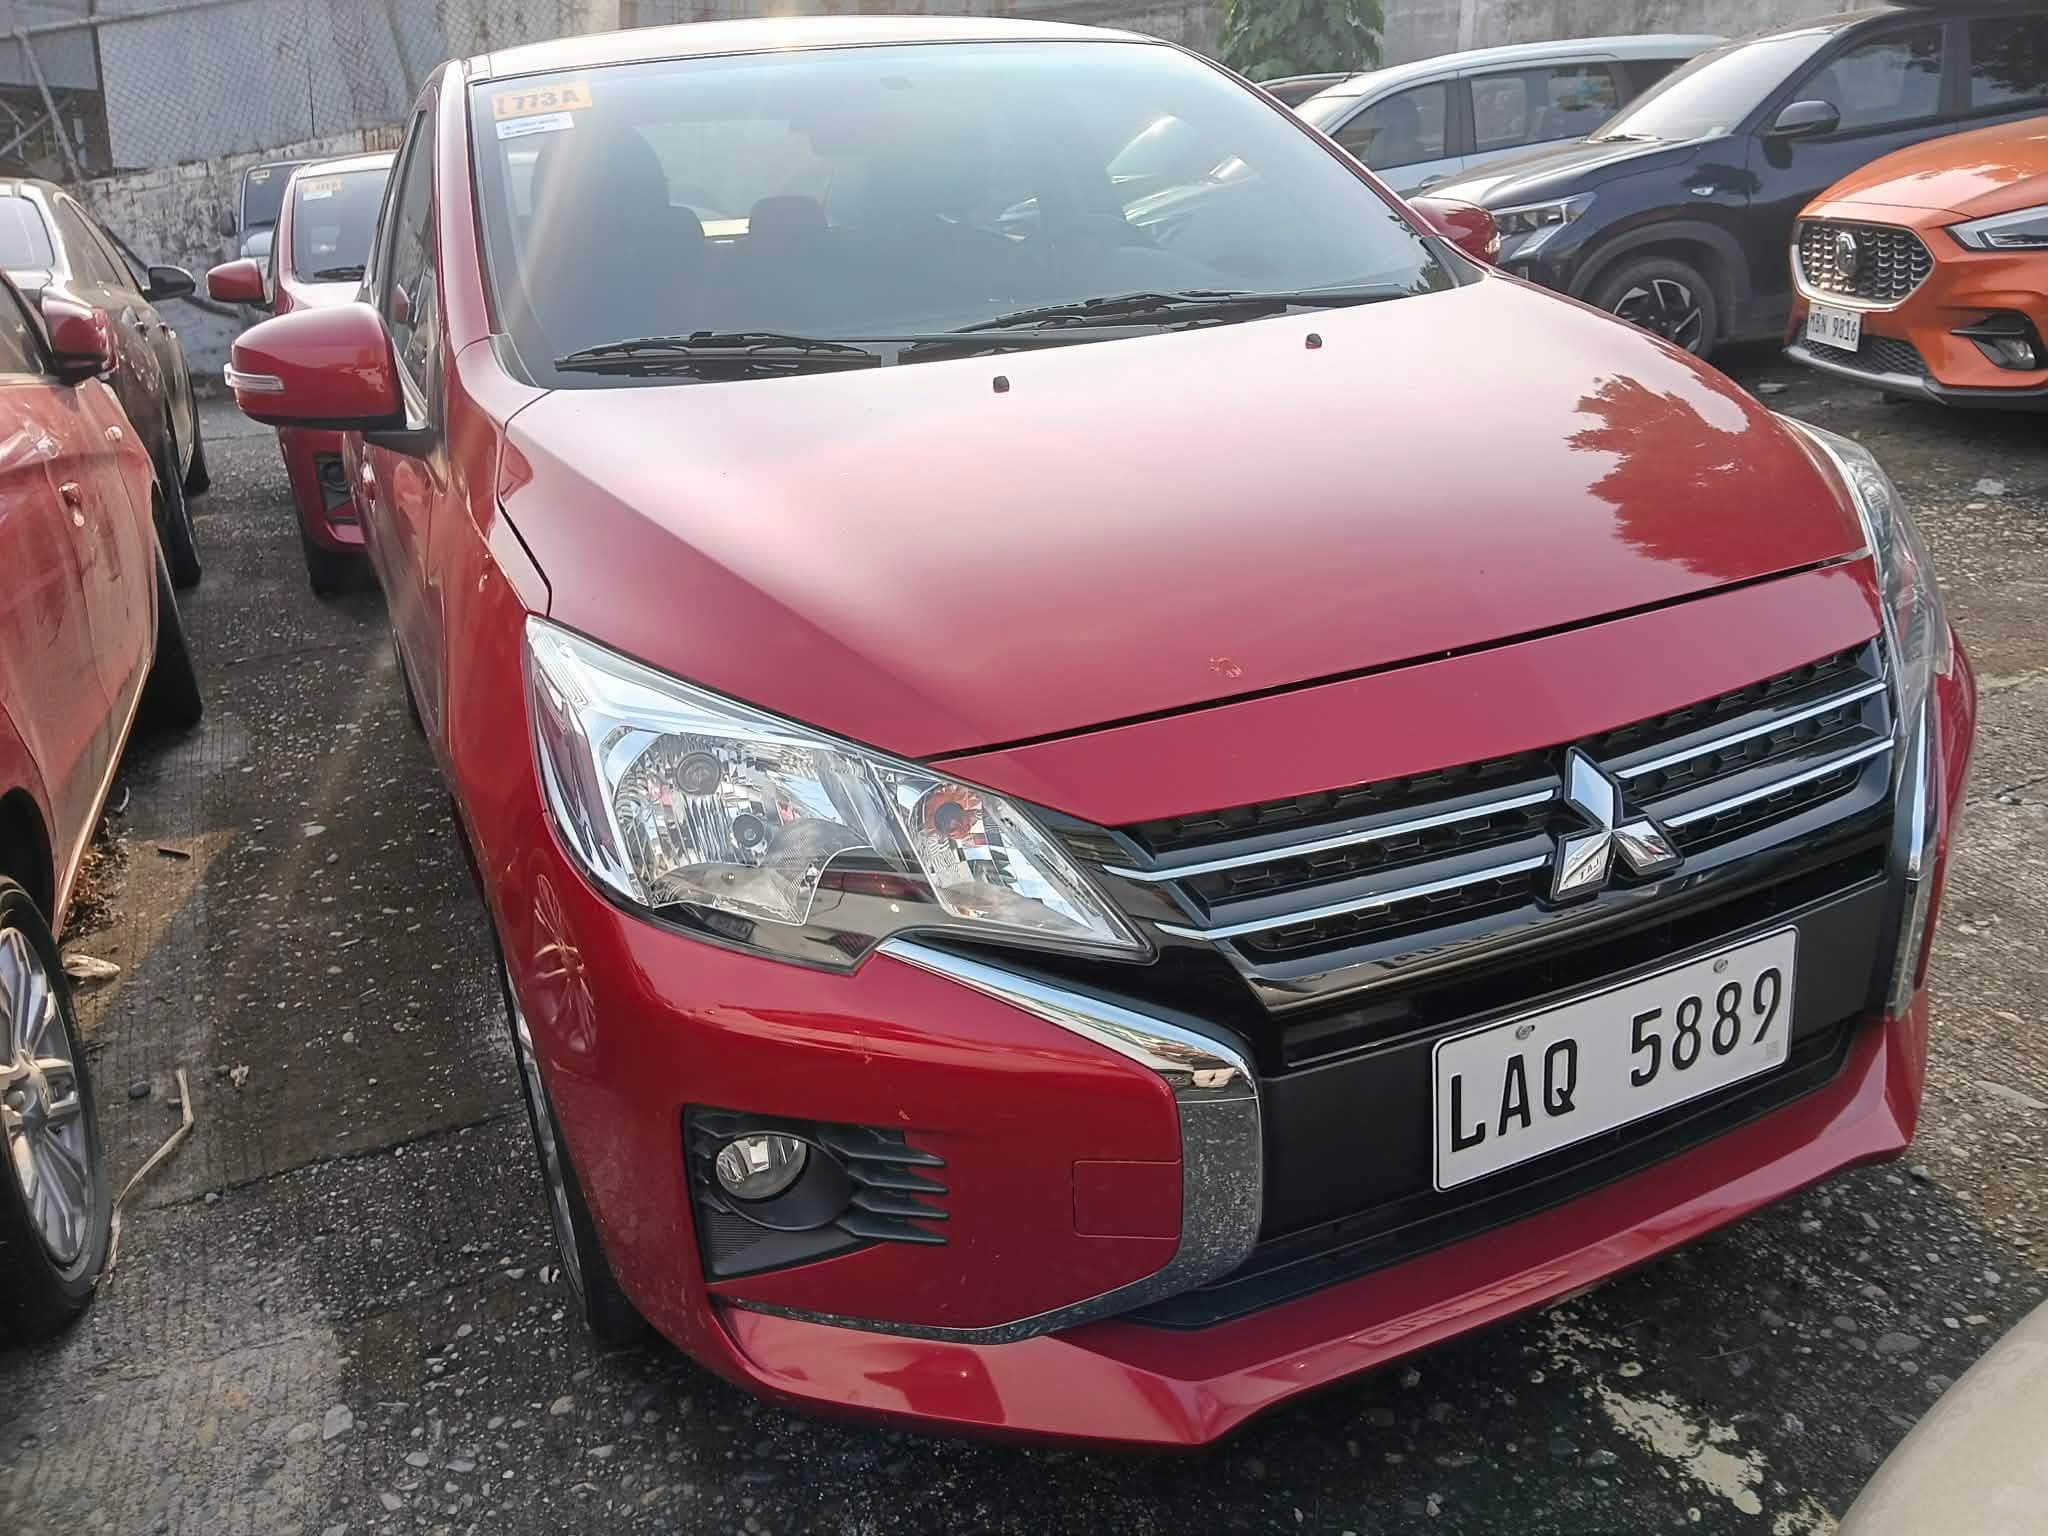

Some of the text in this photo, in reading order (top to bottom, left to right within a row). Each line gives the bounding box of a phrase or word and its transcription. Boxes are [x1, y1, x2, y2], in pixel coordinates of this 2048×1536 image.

[1832, 317, 1857, 342] 9816
[1451, 968, 1782, 1152] LAQ 5889
